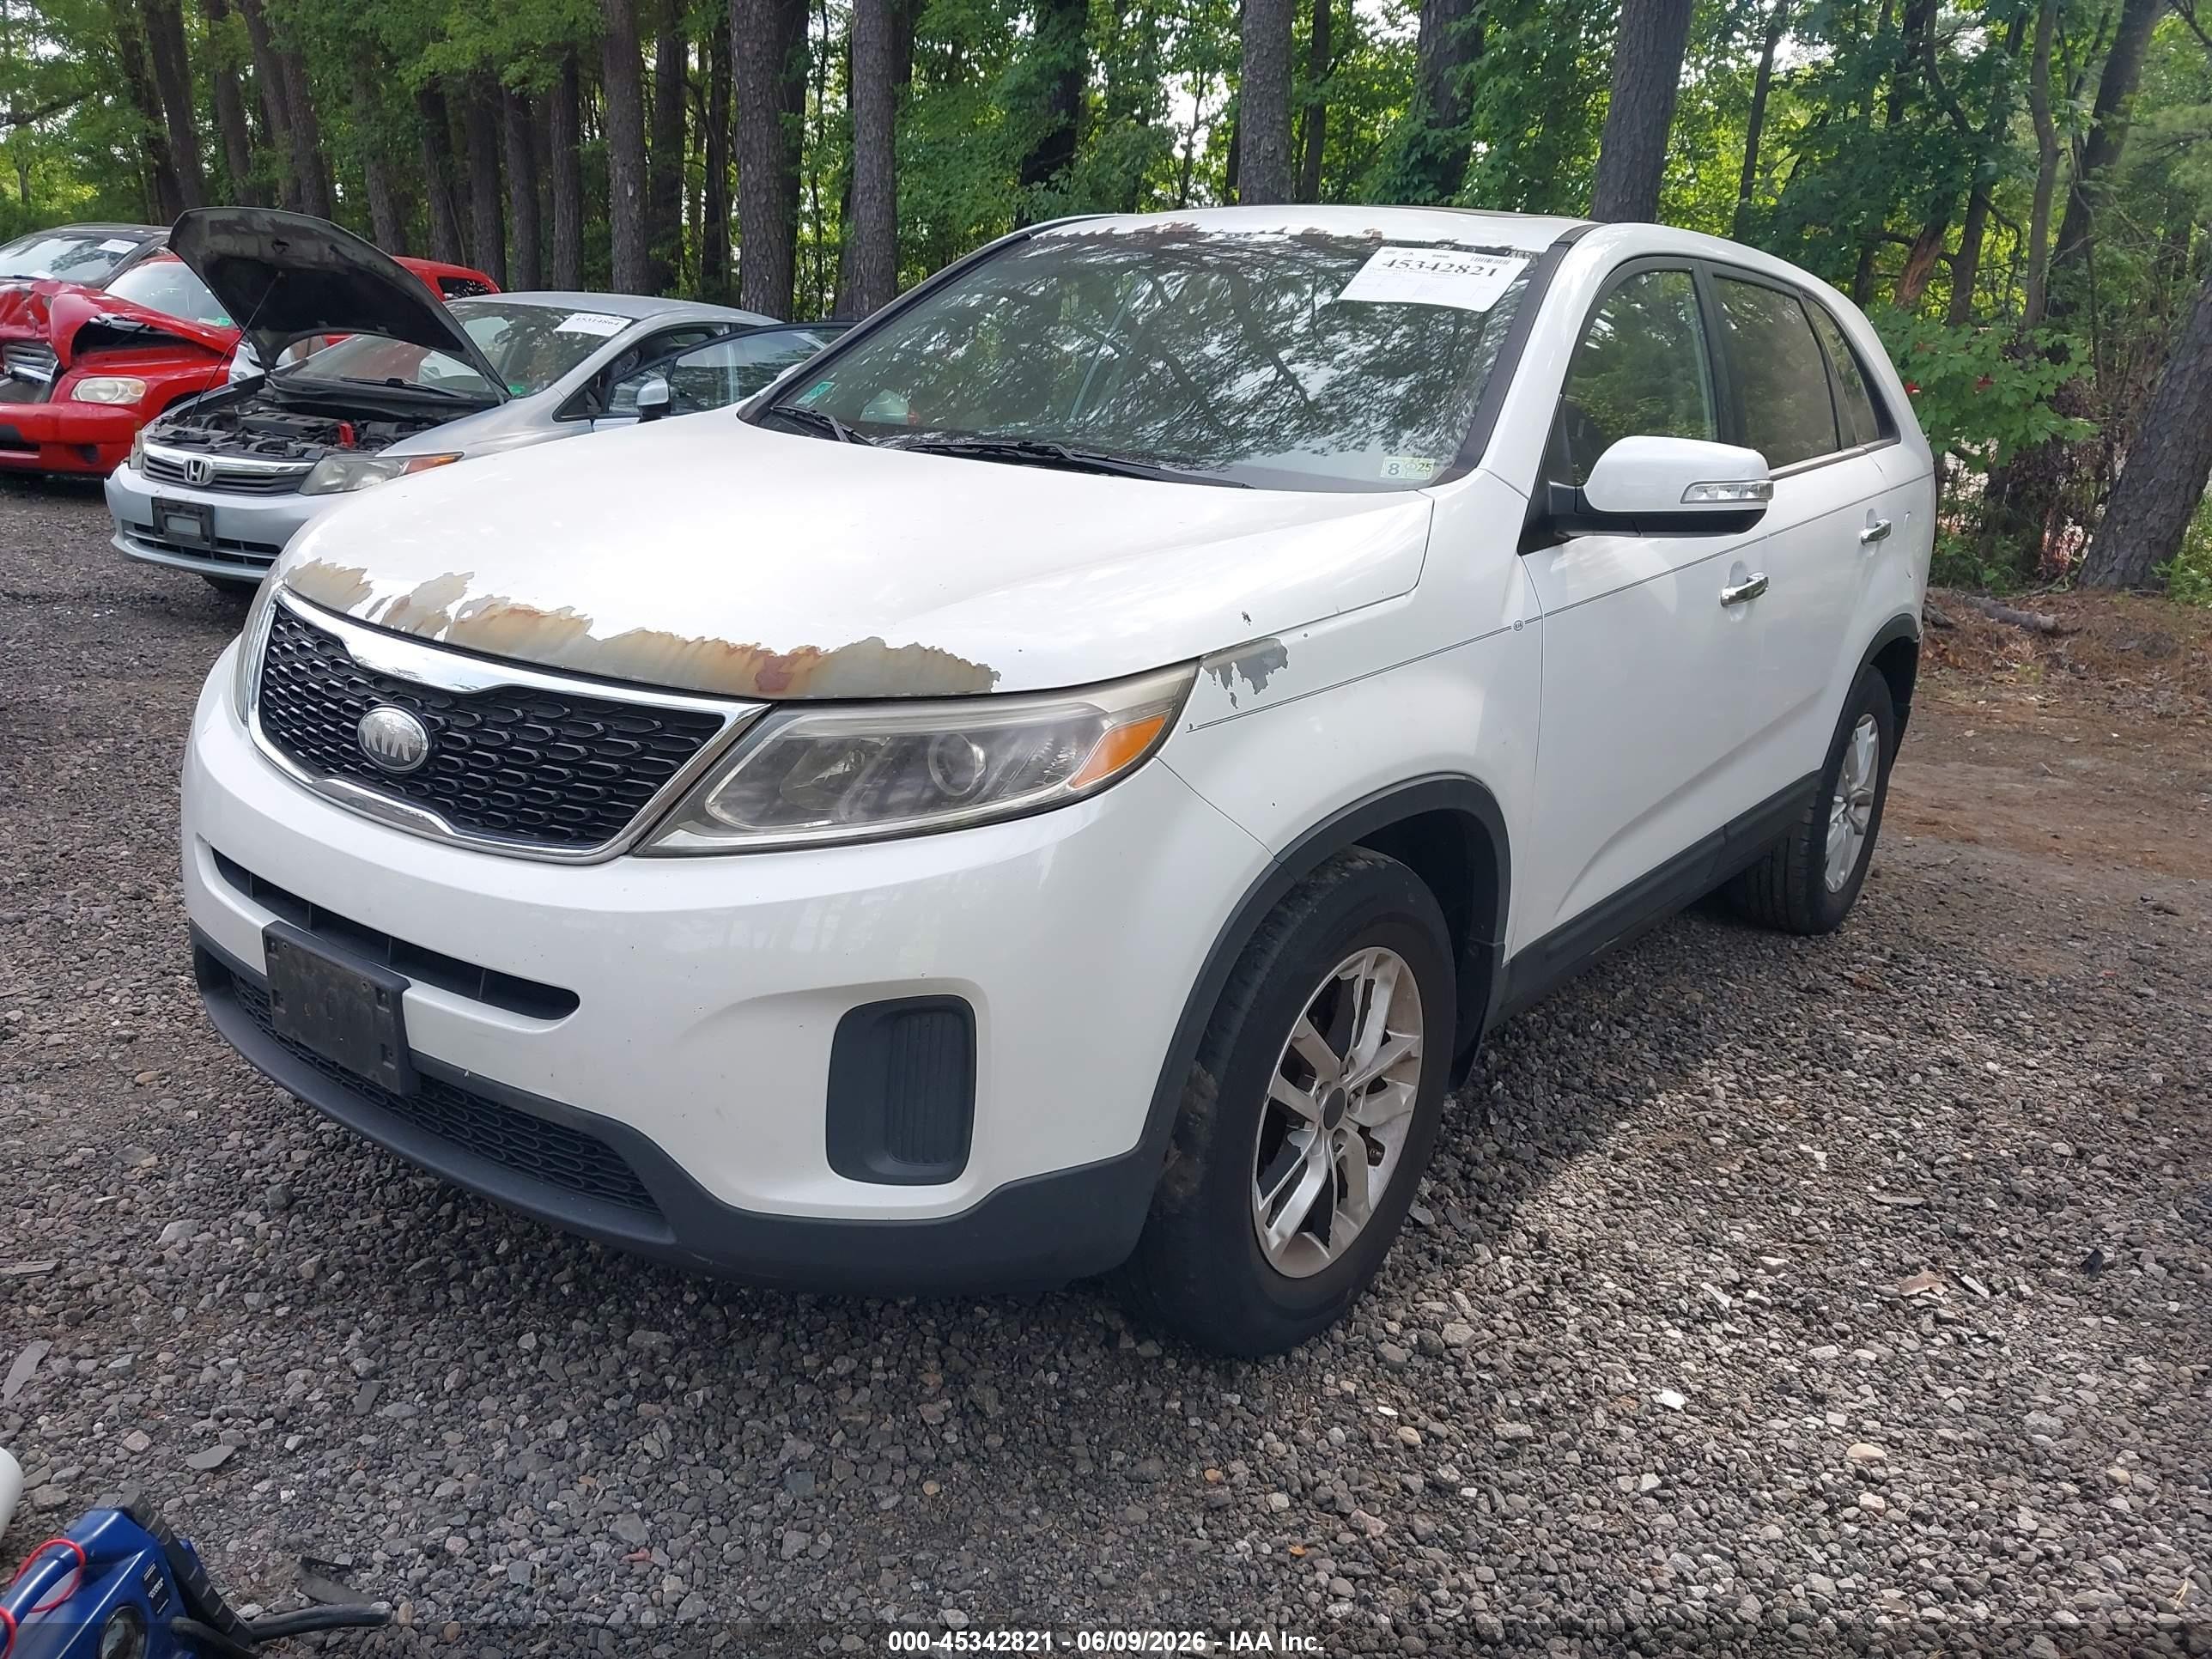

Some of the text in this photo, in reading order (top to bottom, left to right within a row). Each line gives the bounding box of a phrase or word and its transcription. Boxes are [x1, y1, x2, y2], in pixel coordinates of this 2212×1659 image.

[1382, 258, 1498, 277] 45342821
[1387, 462, 1433, 476] 8 25
